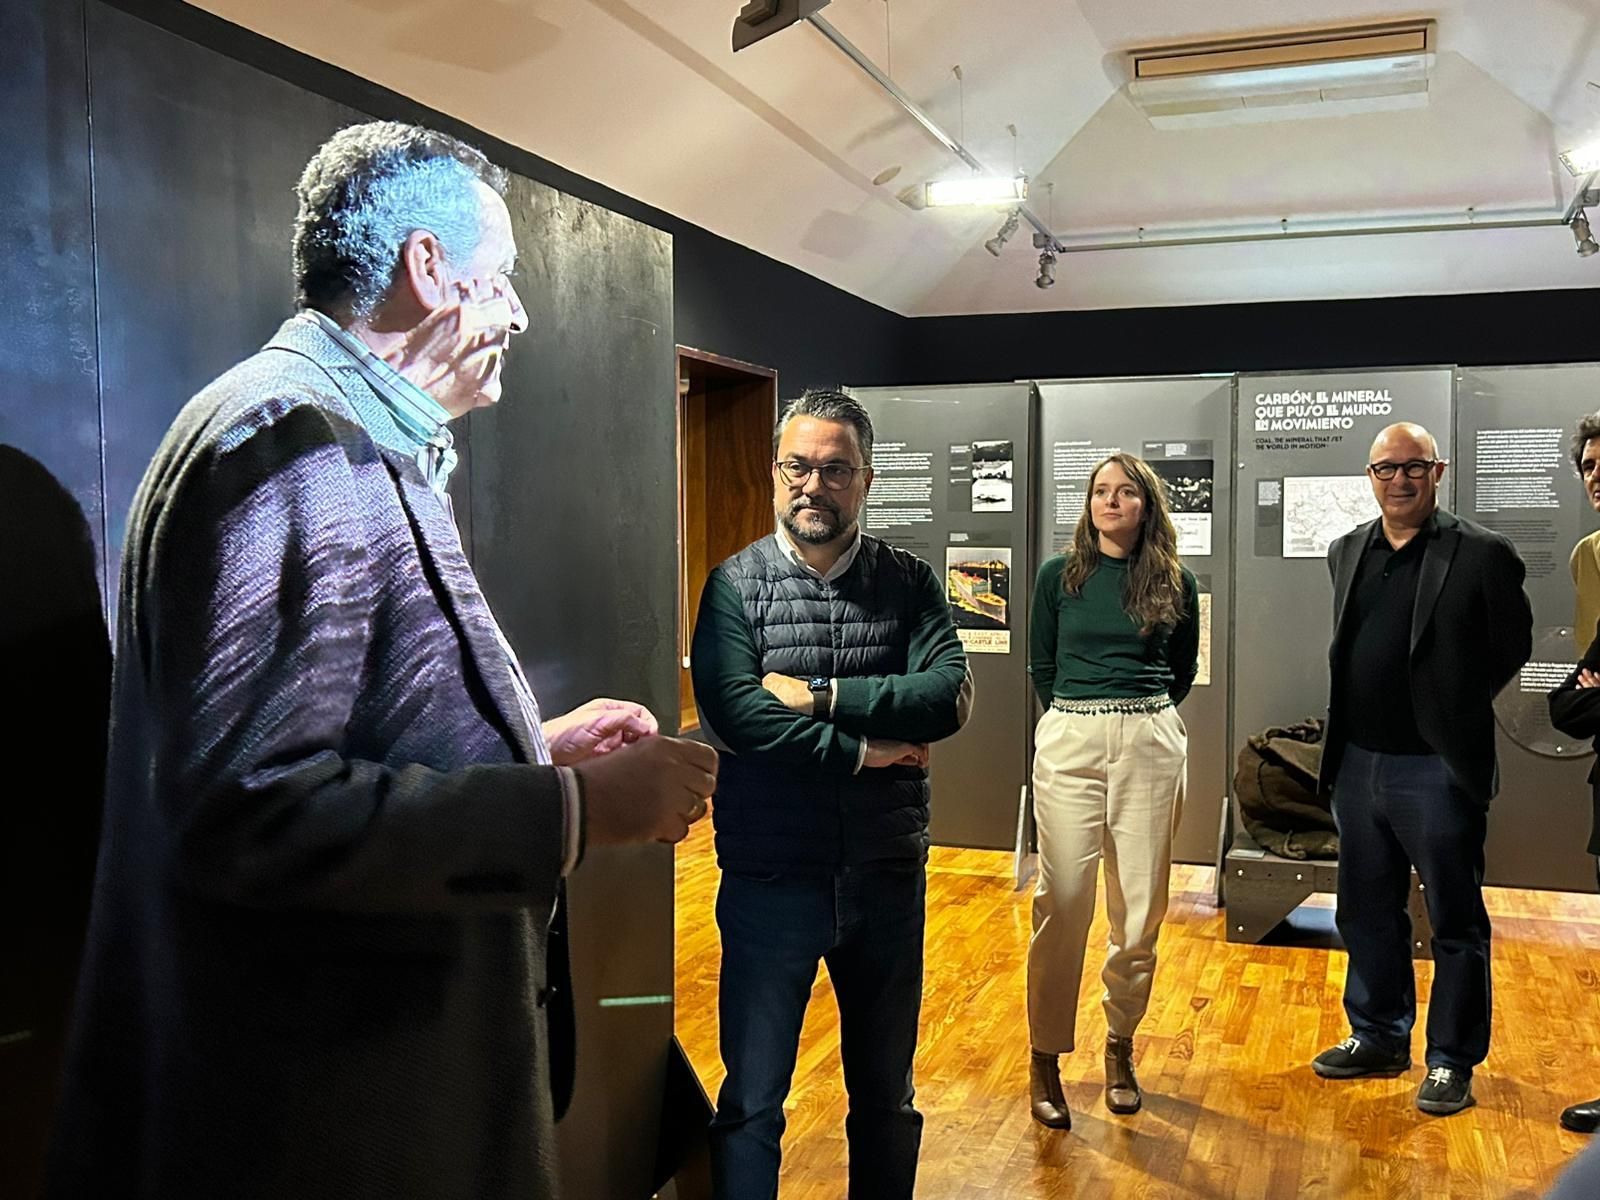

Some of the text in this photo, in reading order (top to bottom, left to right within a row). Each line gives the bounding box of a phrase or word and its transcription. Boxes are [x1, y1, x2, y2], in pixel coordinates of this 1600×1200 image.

[1255, 389, 1392, 405] CARBÓN, EL MINERAL
[1255, 402, 1392, 419] QUE PUSO EL MUNDO
[1255, 416, 1354, 431] EN MOVIMIENTO
